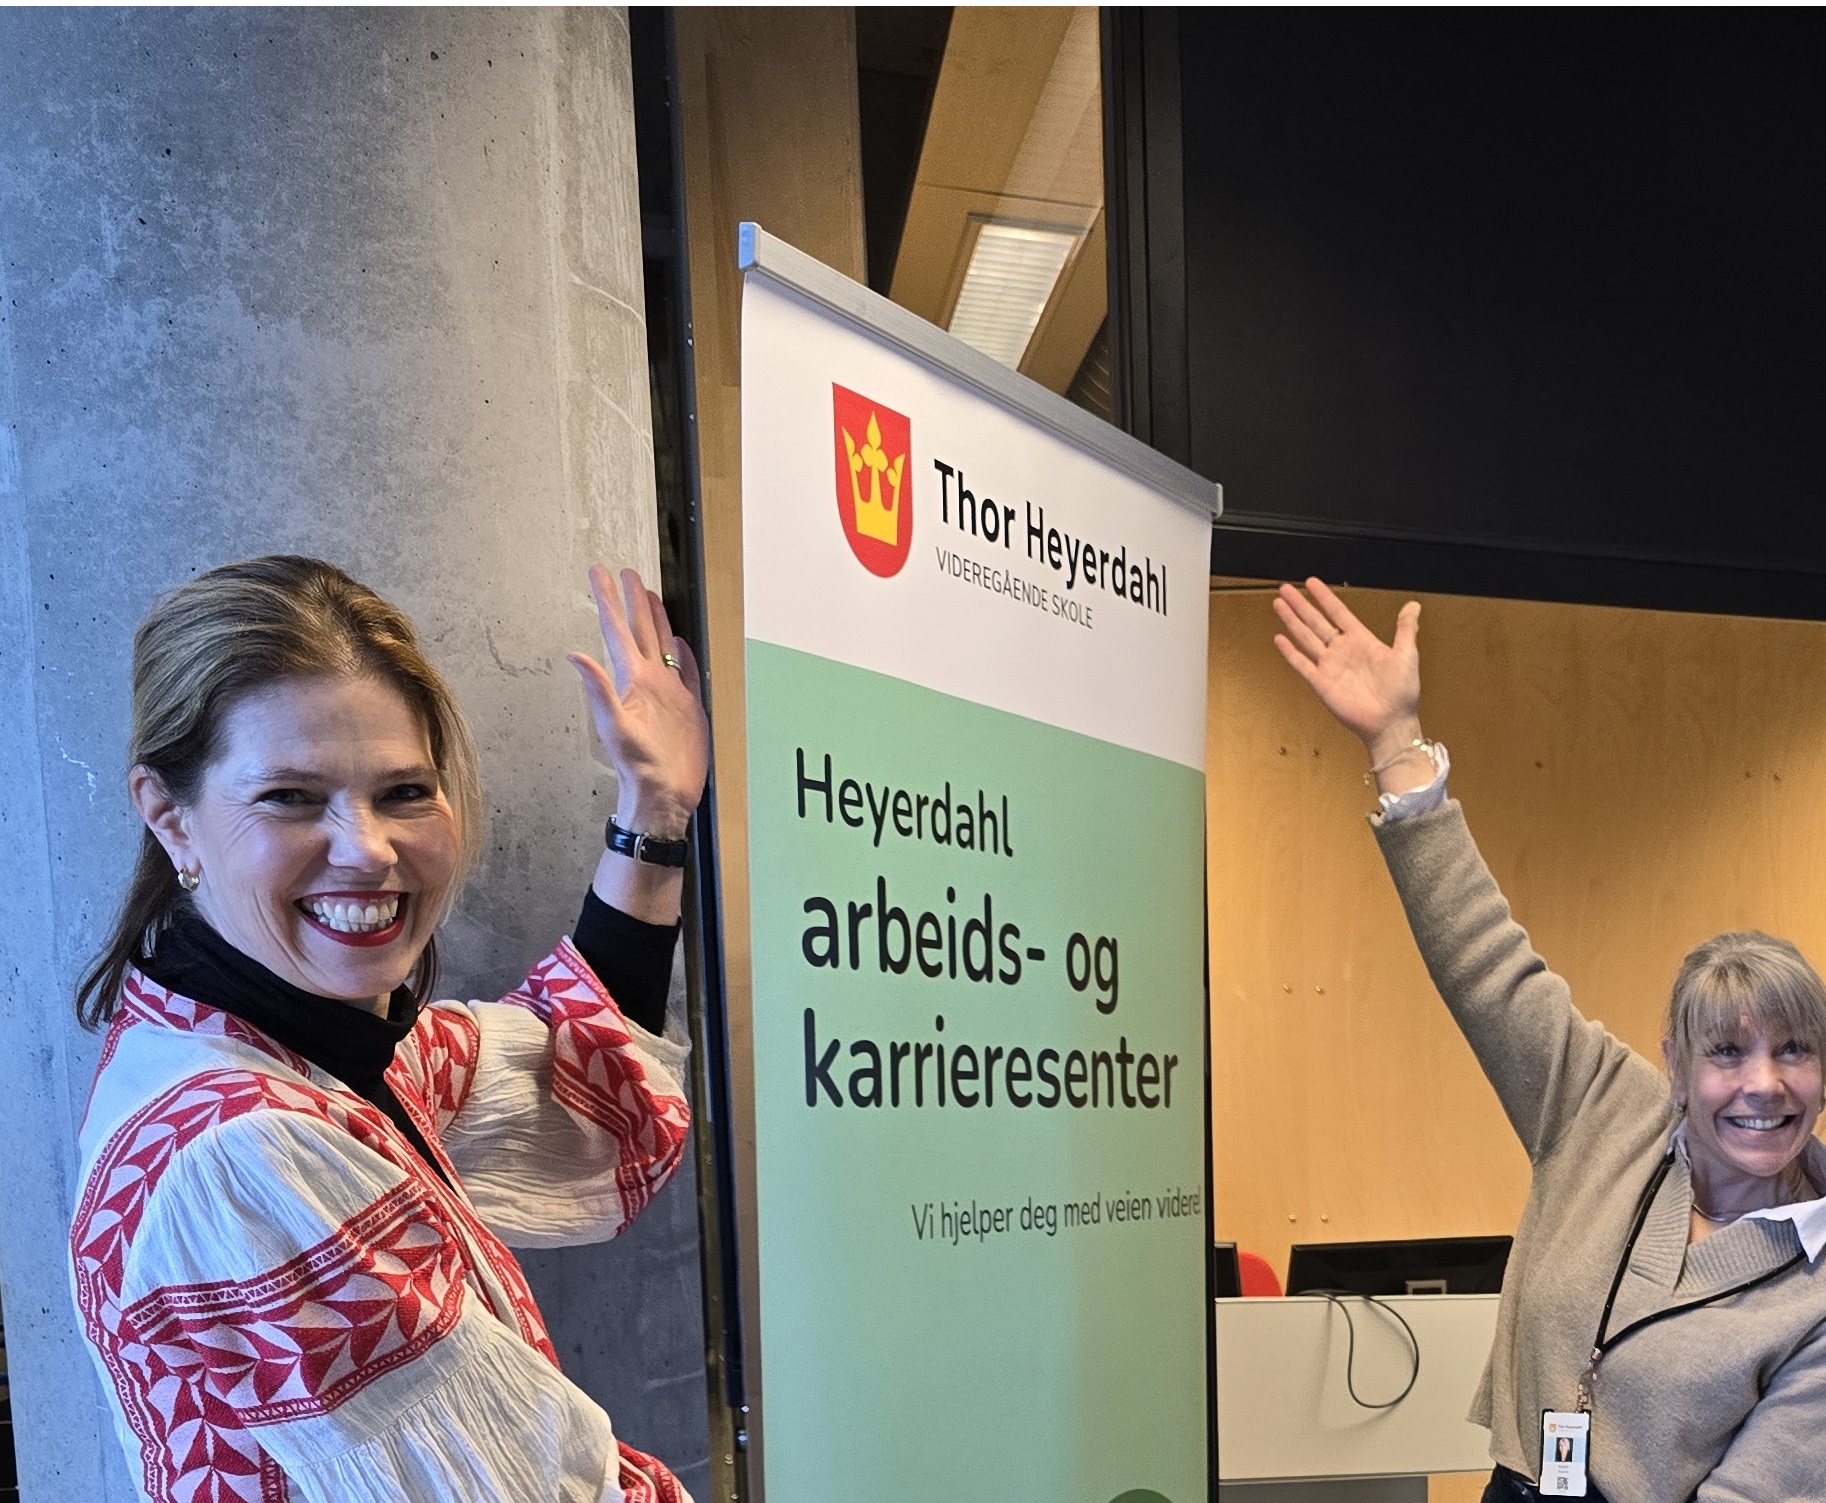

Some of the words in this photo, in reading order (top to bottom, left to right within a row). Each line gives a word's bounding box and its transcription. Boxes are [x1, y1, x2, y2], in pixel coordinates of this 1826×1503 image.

[933, 458, 1017, 551] Thor
[1025, 500, 1168, 617] Heyerdahl
[935, 547, 1049, 613] VIDEREGÅENDE
[1052, 594, 1094, 629] SKOLE
[795, 746, 1014, 859] Heyerdahl
[801, 874, 1047, 986] arbeids-
[1065, 931, 1120, 1016] og
[803, 1007, 1179, 1110] karrieresenter
[911, 1203, 934, 1240] Vi
[941, 1200, 1014, 1246] hjelper
[1020, 1196, 1057, 1237] deg
[1064, 1191, 1101, 1228] med
[1105, 1190, 1151, 1223] veien
